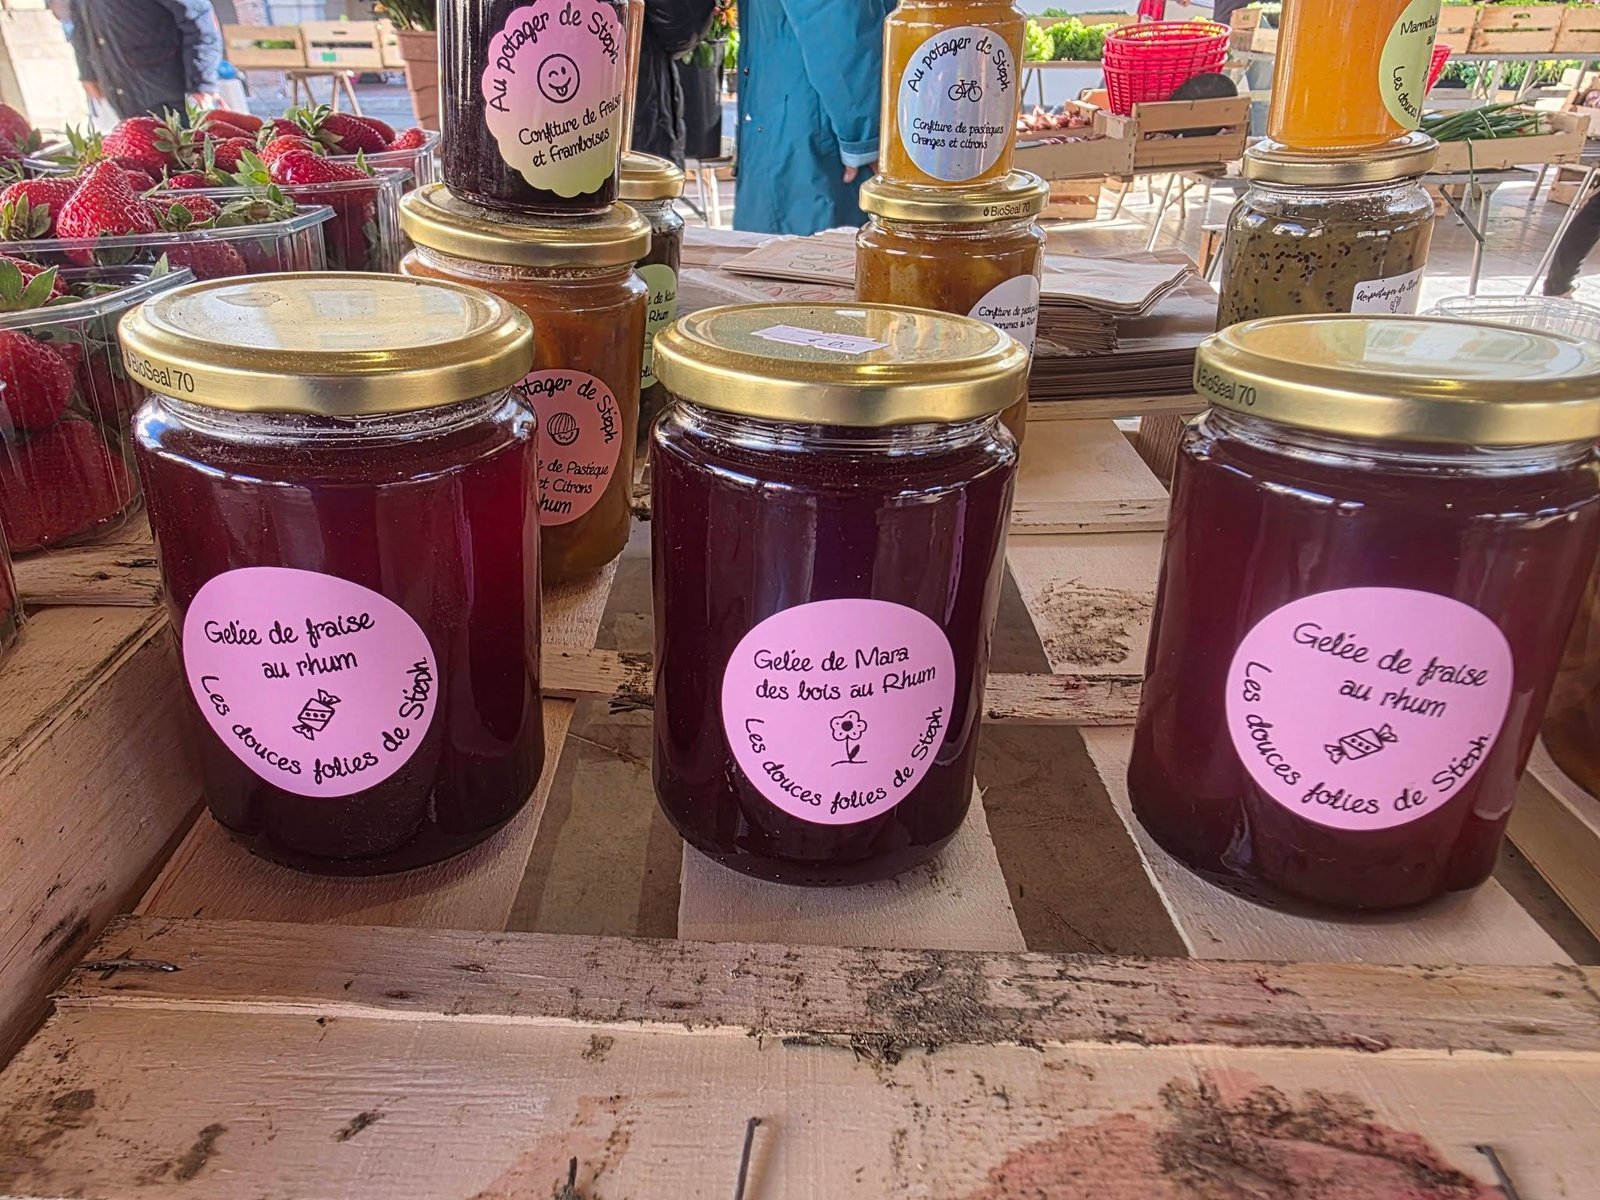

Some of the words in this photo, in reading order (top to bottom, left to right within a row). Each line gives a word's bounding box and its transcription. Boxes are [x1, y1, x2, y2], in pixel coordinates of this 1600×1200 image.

[559, 2, 582, 26] de
[497, 12, 549, 74] potager
[908, 68, 924, 92] Au
[922, 37, 971, 70] potager
[976, 36, 992, 55] de
[1393, 66, 1405, 91] Les
[490, 79, 510, 112] Au
[1398, 92, 1417, 118] douces
[519, 119, 579, 145] Confiture
[583, 108, 597, 126] de
[913, 118, 952, 135] Confiture
[955, 122, 967, 132] de
[912, 133, 945, 150] Oranges
[949, 137, 958, 148] et
[960, 138, 988, 149] citrons
[532, 152, 547, 167] et
[990, 205, 1021, 217] BioSeal
[1022, 202, 1030, 213] 70
[979, 306, 1011, 319] Confiture
[1013, 306, 1020, 316] de
[131, 352, 172, 388] BioSeal
[173, 370, 194, 392] 70
[577, 379, 597, 400] de
[1200, 368, 1236, 400] BioSeal
[1238, 384, 1256, 406] 70
[547, 458, 564, 472] de
[552, 478, 592, 494] Citrons
[540, 493, 572, 514] hum
[204, 620, 262, 645] Gelée
[268, 621, 298, 644] de
[306, 612, 375, 648] fraise
[262, 662, 290, 679] au
[296, 652, 358, 676] rhum
[754, 649, 814, 672] Gelée
[821, 650, 848, 670] de
[856, 647, 910, 668] Mara
[1294, 622, 1370, 663] Gelée
[1377, 648, 1412, 674] de
[1416, 656, 1488, 686] fraise
[756, 678, 789, 699] des
[797, 680, 841, 700] bois
[850, 682, 874, 698] au
[882, 666, 936, 693] Rhum
[1242, 661, 1272, 702] Les
[1339, 680, 1373, 702] au
[1380, 687, 1448, 718] rhum
[201, 675, 230, 716] Les
[232, 724, 302, 774] douces
[313, 752, 378, 785] folies
[382, 727, 410, 752] de
[1246, 714, 1302, 786] douces
[745, 718, 766, 754] Les
[762, 761, 822, 806] douces
[830, 786, 887, 814] folies
[893, 766, 914, 788] de
[1302, 782, 1380, 814] folies
[1394, 788, 1428, 811] de
